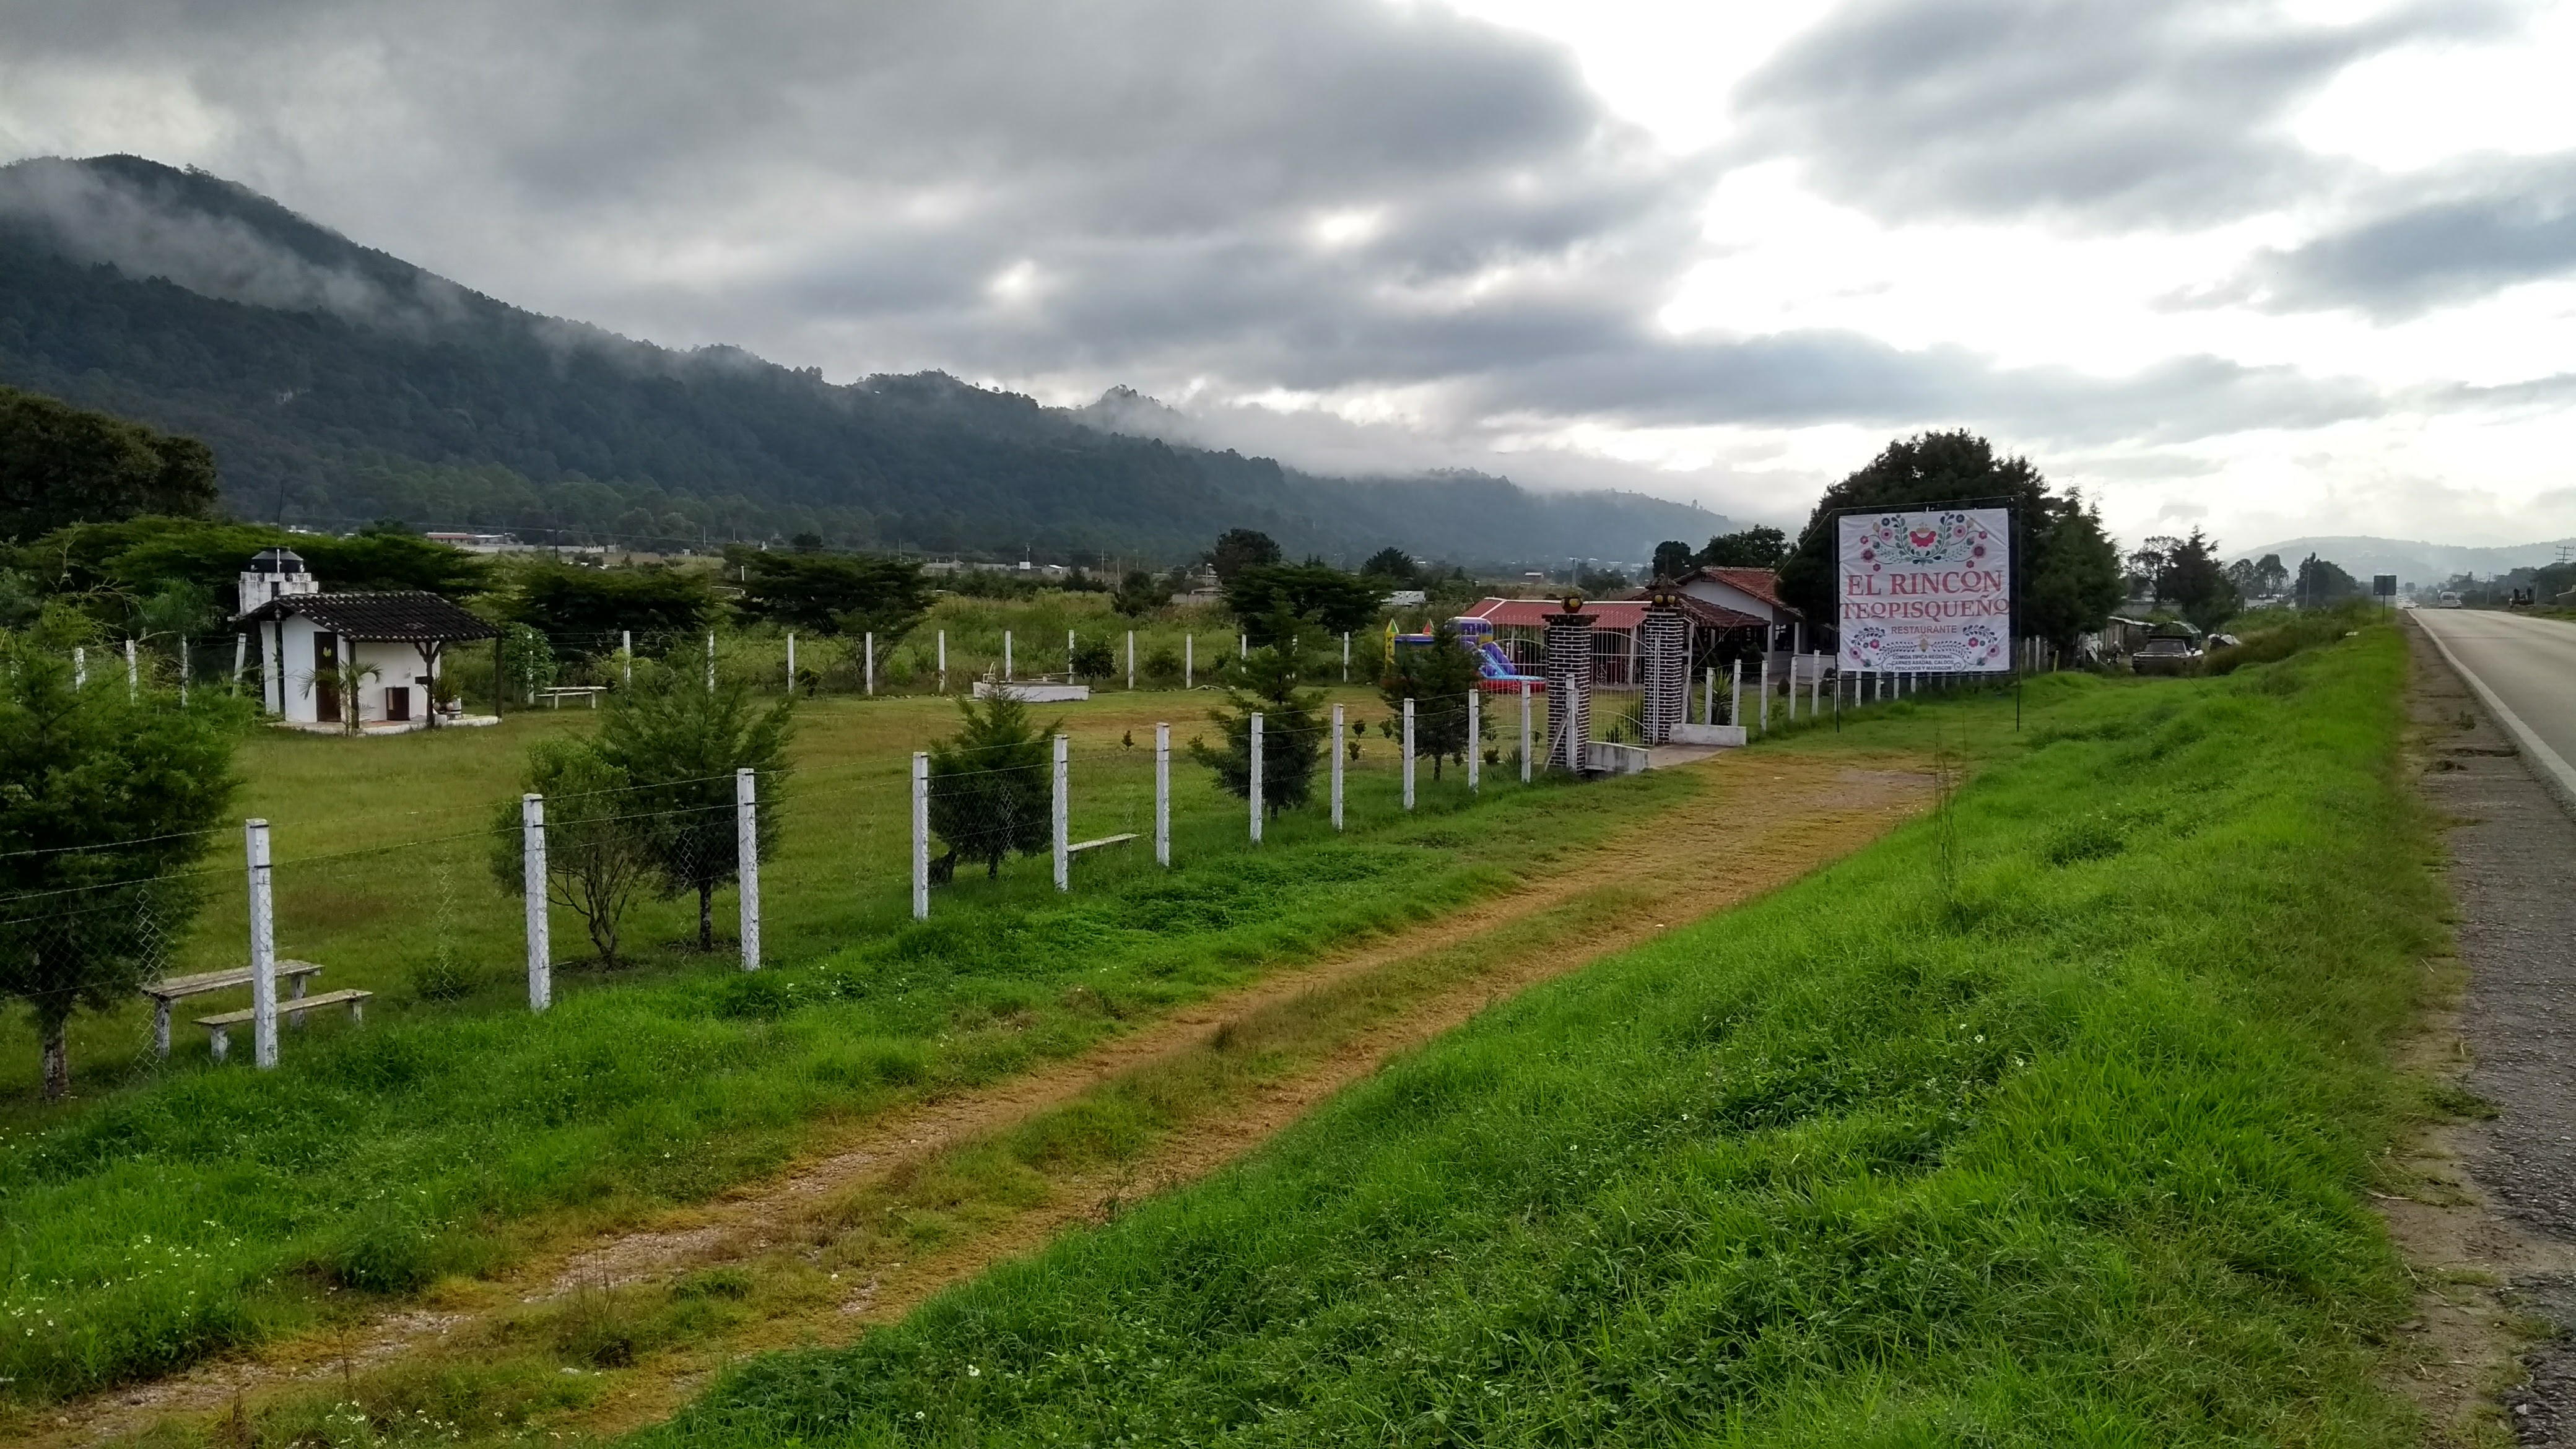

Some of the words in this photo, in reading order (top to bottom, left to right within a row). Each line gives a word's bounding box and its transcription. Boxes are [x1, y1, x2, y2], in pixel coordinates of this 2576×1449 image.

[1847, 574, 1881, 596] EL
[1889, 570, 2003, 595] RINCON
[1840, 594, 2009, 622] TEOPISQUEÑO
[1891, 625, 1957, 634] RESTAURANTE
